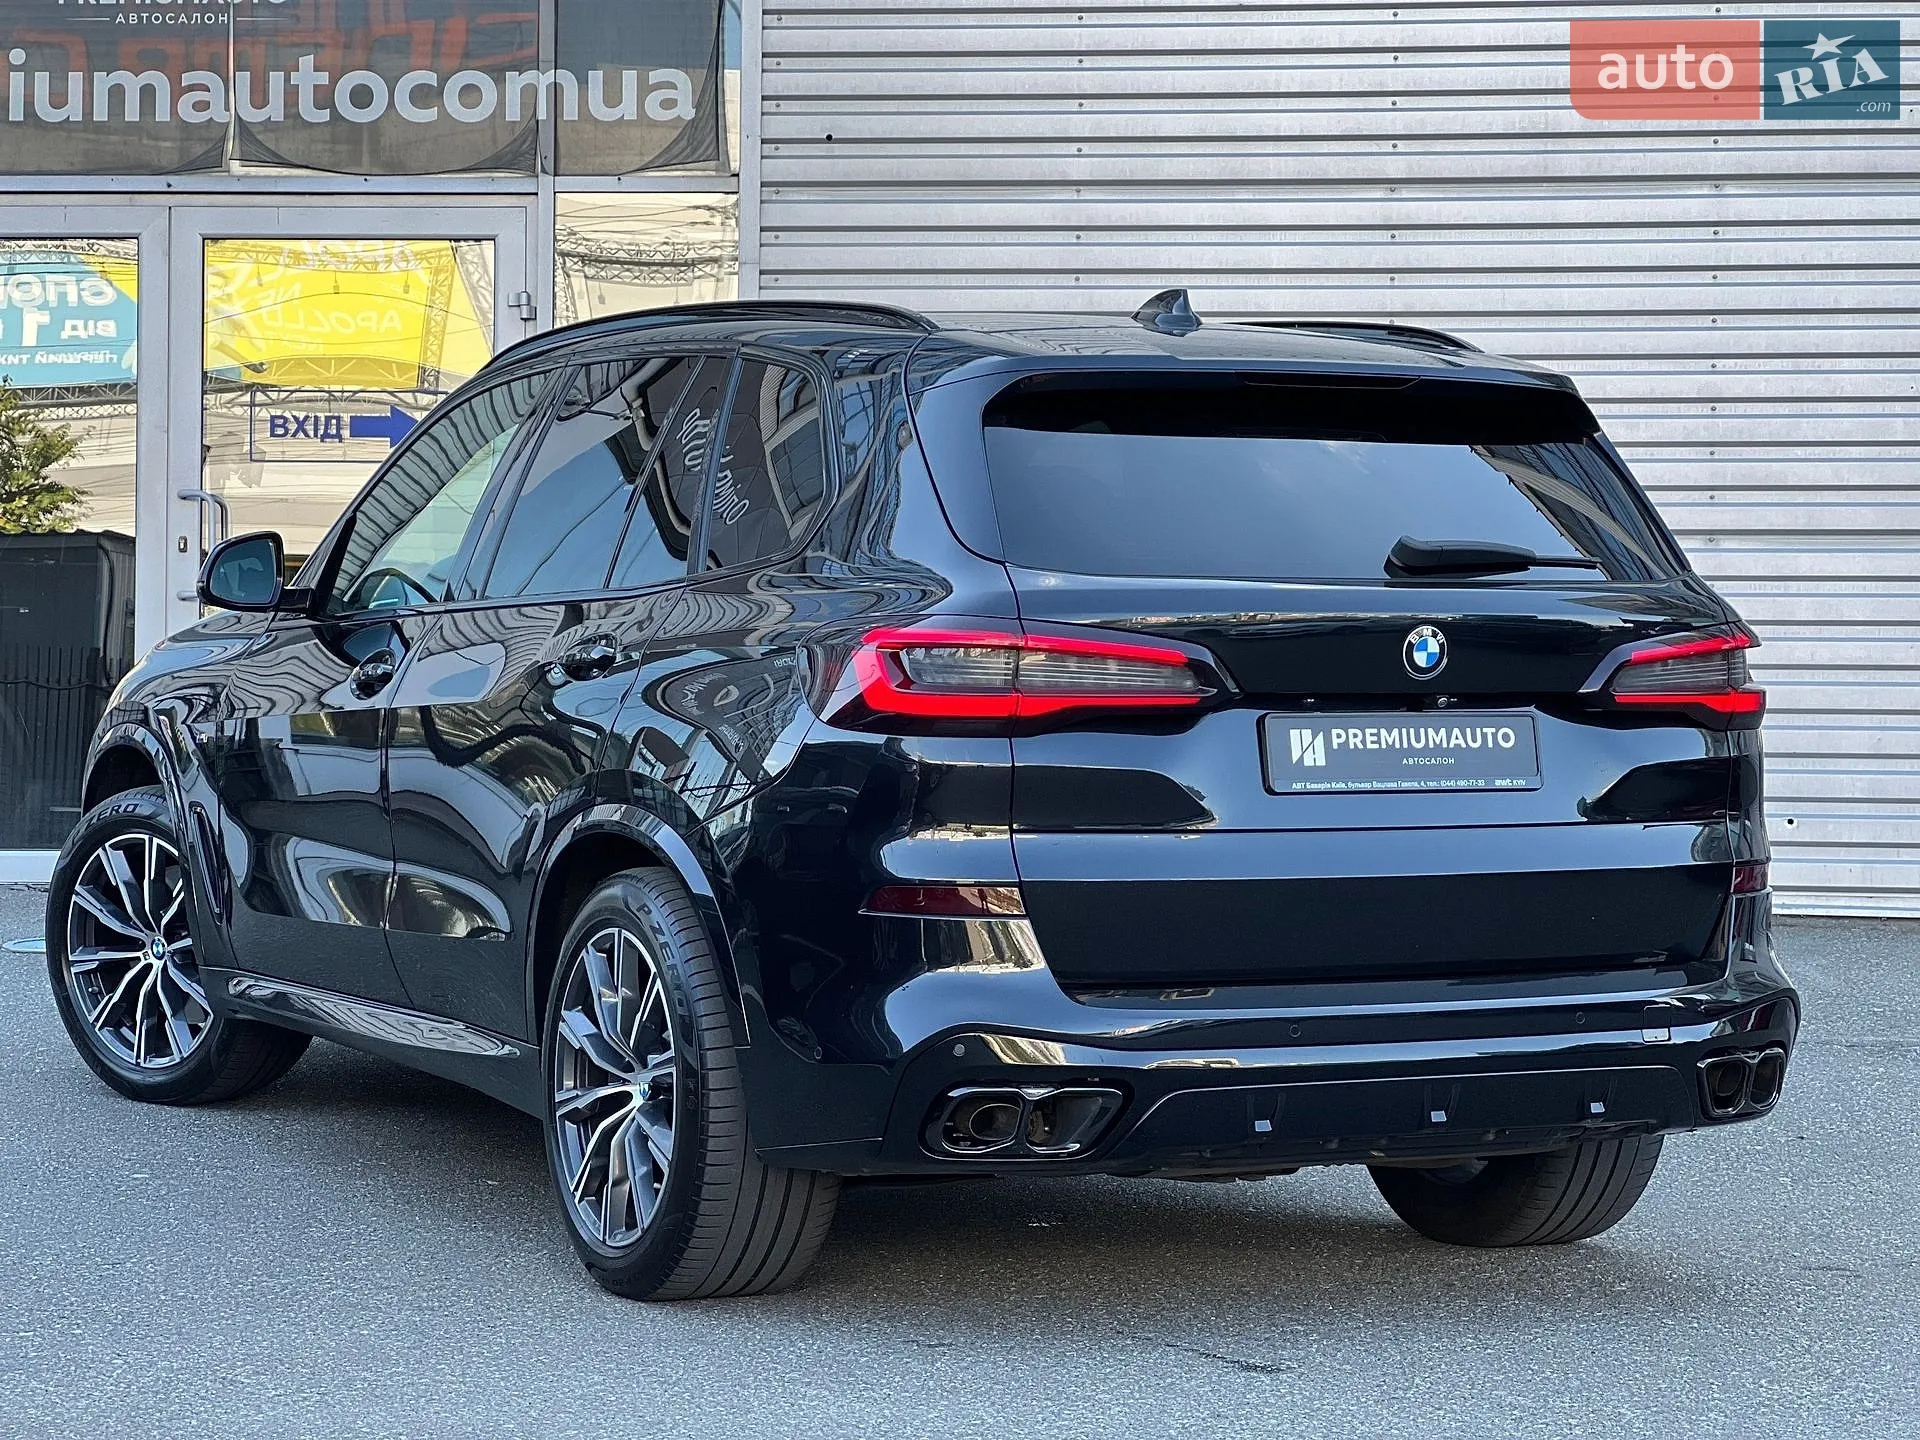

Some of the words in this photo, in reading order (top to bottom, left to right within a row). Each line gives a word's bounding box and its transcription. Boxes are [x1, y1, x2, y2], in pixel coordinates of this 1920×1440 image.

[115, 13, 228, 24] АВТОСАЛОН
[269, 414, 345, 443] ВХІД
[1409, 628, 1445, 644] BMW
[1331, 727, 1516, 749] PREMIUMAUTO
[1402, 757, 1455, 765] АВТОСАЛОН
